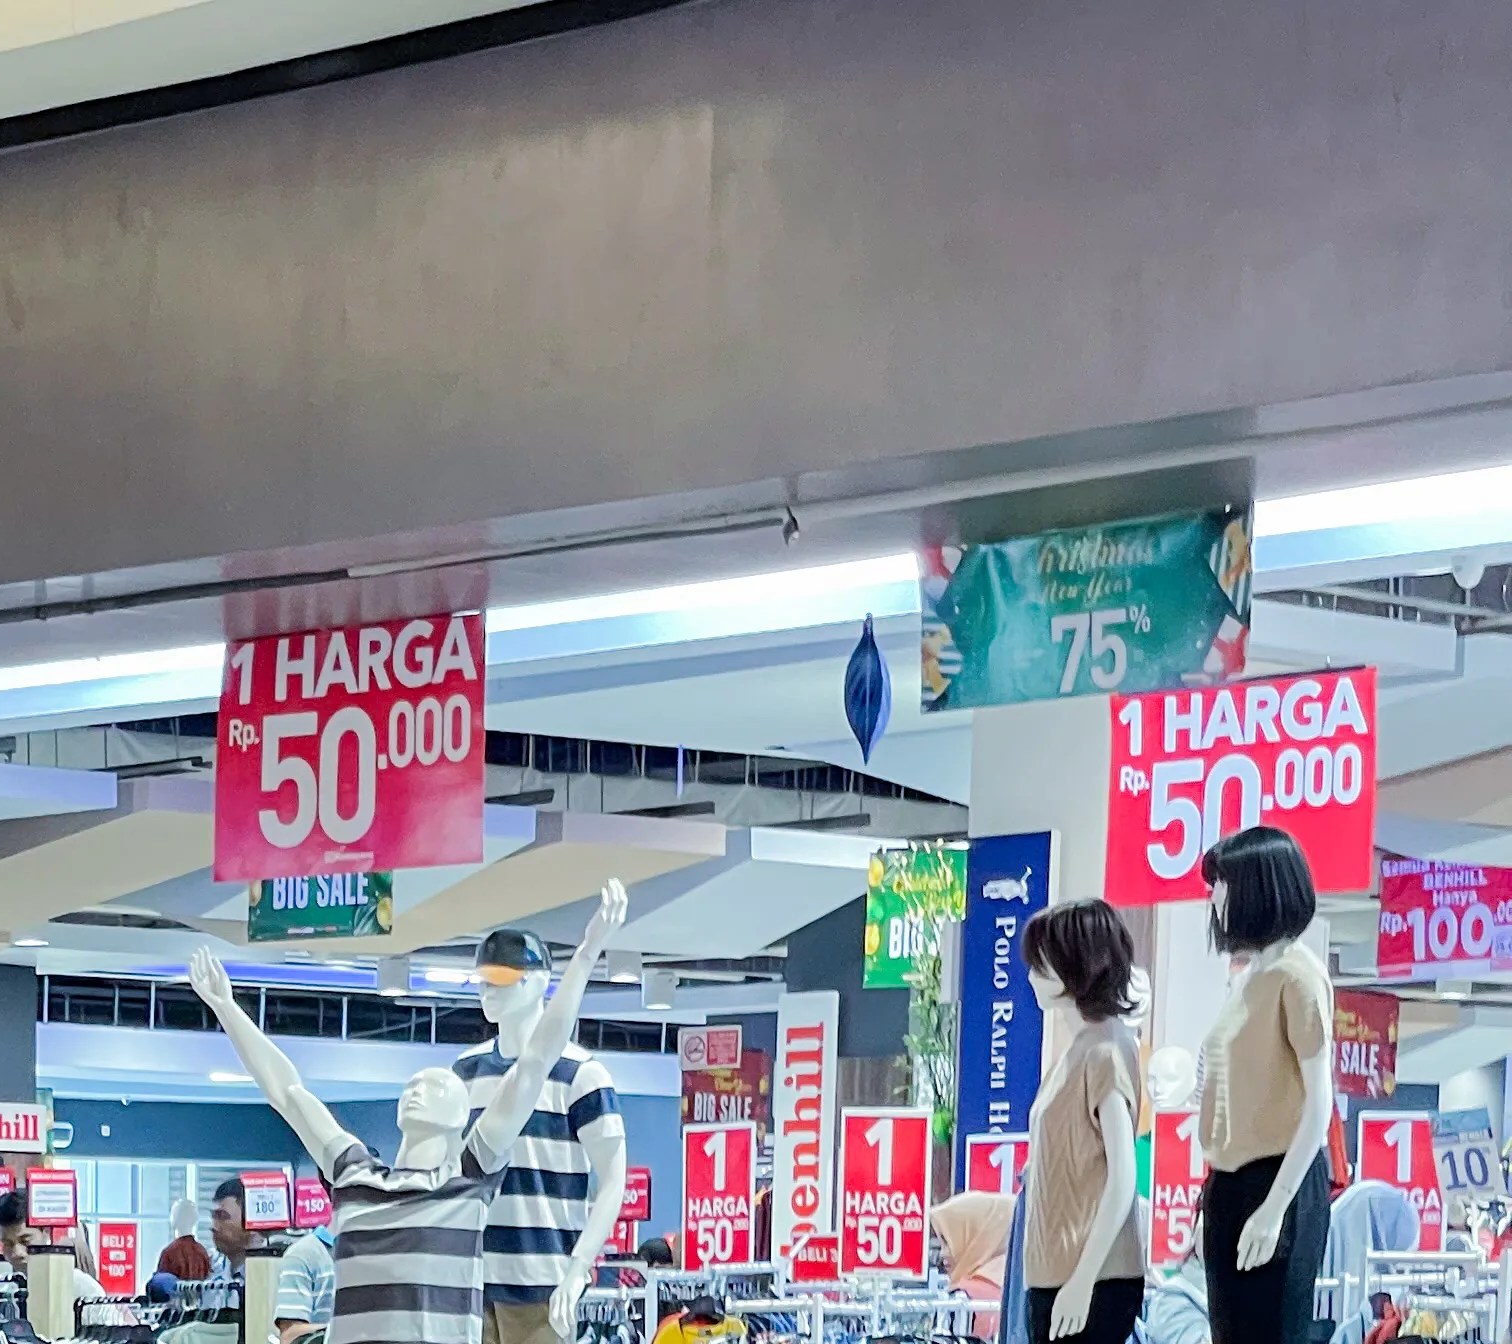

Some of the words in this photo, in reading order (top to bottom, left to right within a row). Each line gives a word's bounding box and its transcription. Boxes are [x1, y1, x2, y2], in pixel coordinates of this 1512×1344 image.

[231, 643, 255, 705] 1
[275, 617, 478, 702] HARGA
[1118, 700, 1144, 756] 1
[1163, 678, 1368, 754] HARGA
[272, 877, 309, 911] BIG
[316, 873, 369, 907] SALE
[1341, 1041, 1379, 1076] SALE
[694, 1091, 716, 1121] BIG
[720, 1094, 752, 1122] SALE
[704, 1132, 727, 1191] 1
[865, 1119, 893, 1186] 1
[1384, 1121, 1412, 1182] 1
[1442, 1148, 1488, 1190] 10
[688, 1197, 748, 1218] HARGA
[846, 1192, 922, 1215] HARGA
[1156, 1185, 1201, 1205] HAR
